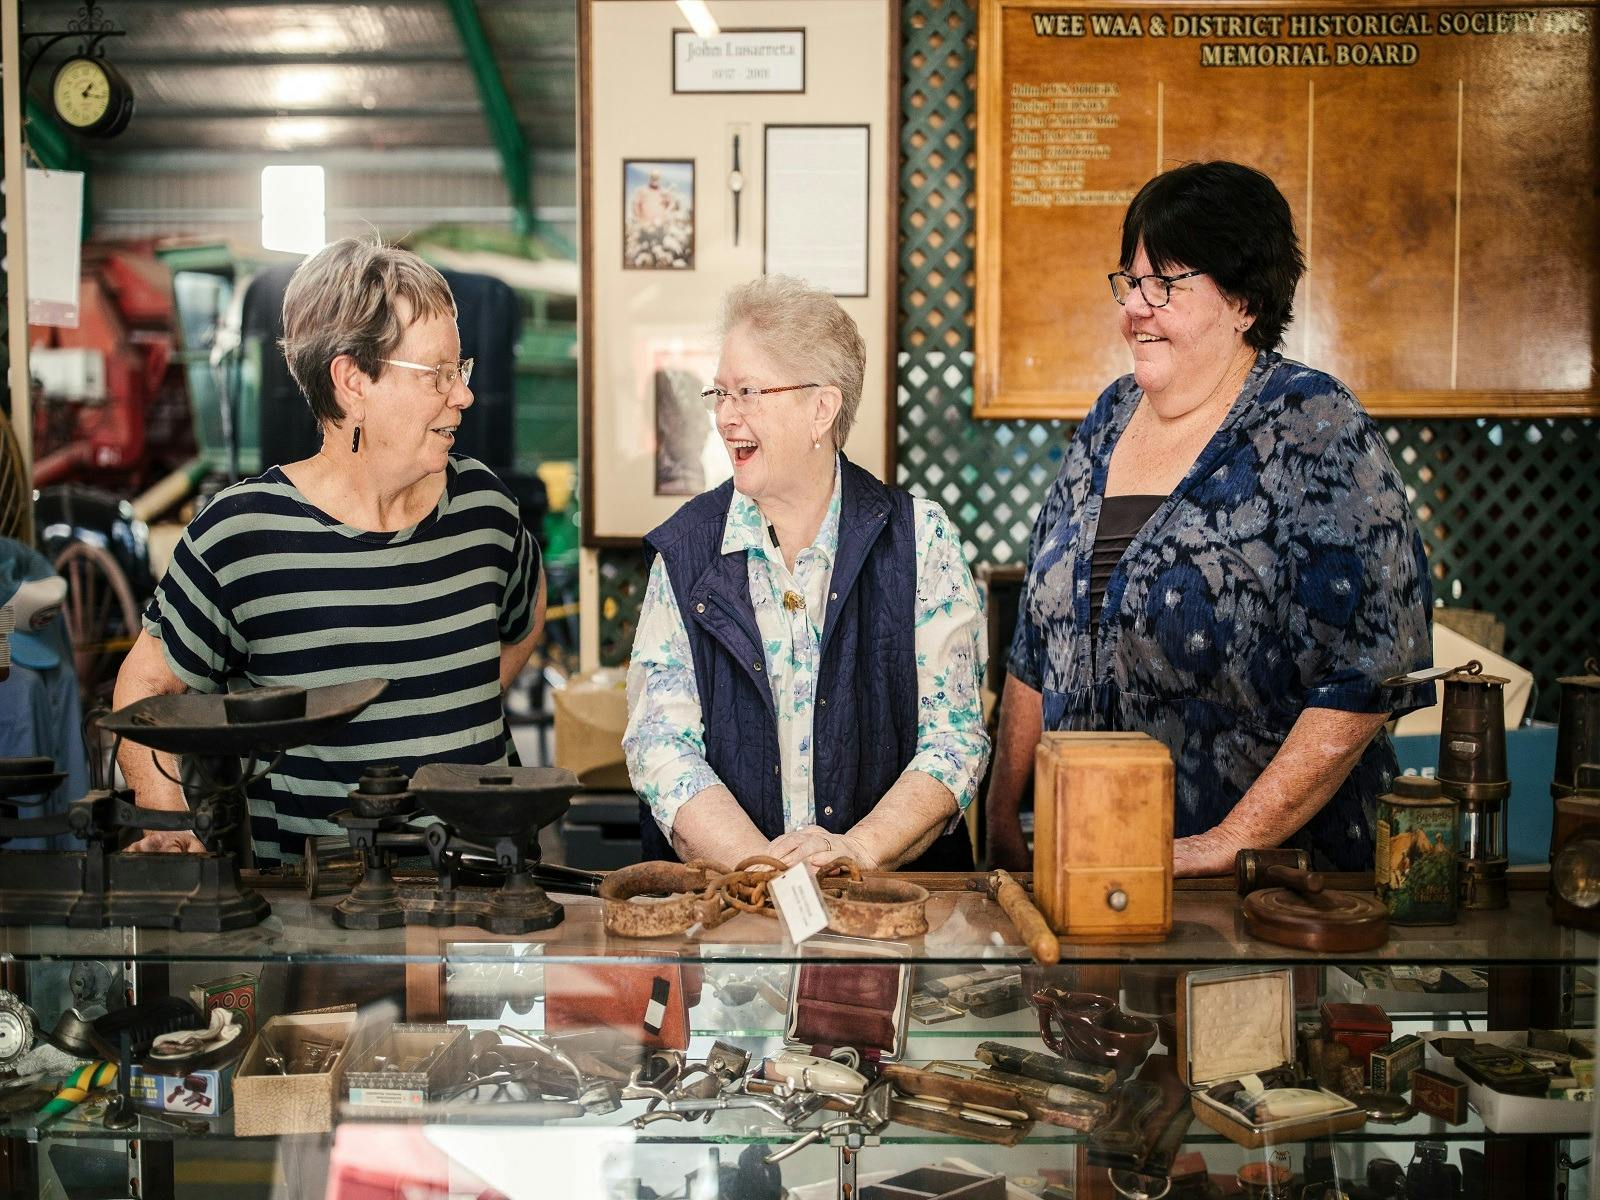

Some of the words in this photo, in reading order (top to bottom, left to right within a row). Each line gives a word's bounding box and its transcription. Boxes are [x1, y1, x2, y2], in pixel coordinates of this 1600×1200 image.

[1033, 14, 1085, 36] WEE
[1090, 14, 1143, 36] WAA
[1149, 15, 1168, 36] &
[1173, 14, 1282, 37] DISTRICT
[1289, 13, 1432, 36] HISTORICAL
[1438, 12, 1537, 35] SOCIETY
[1201, 44, 1329, 66] MEMORIAL
[1335, 44, 1418, 65] BOARD
